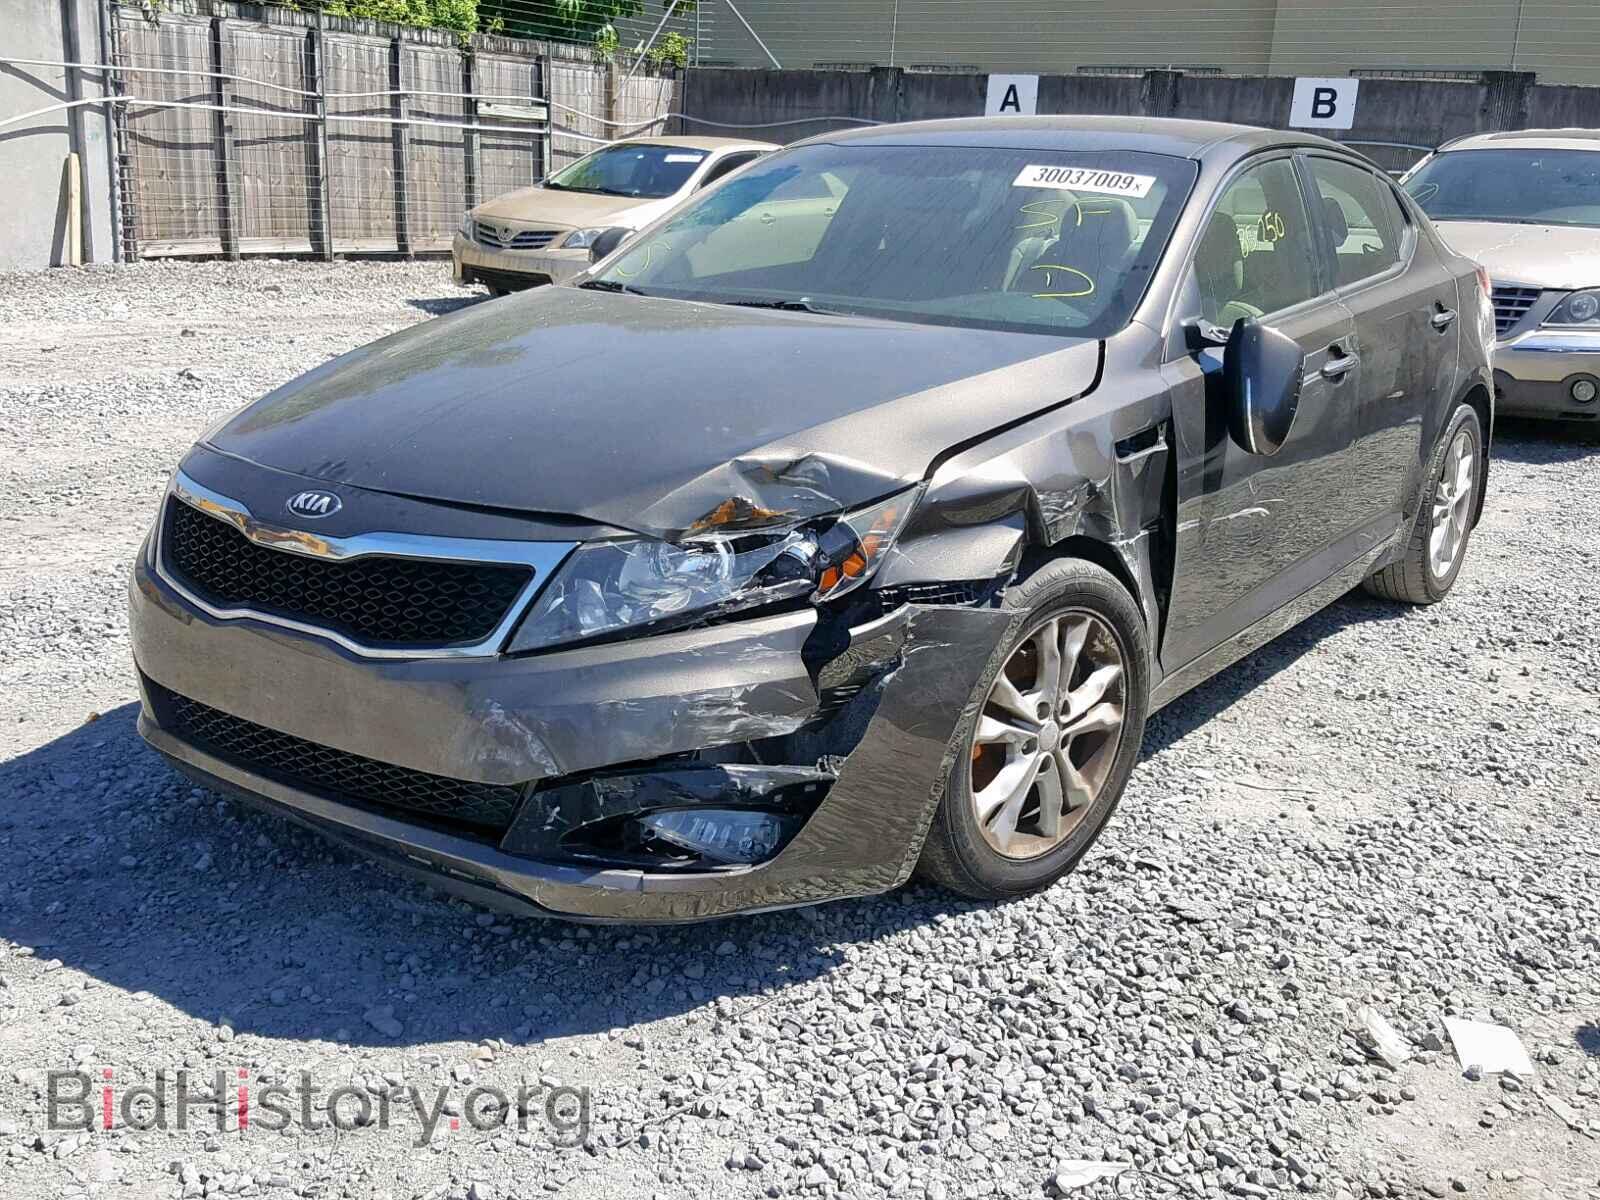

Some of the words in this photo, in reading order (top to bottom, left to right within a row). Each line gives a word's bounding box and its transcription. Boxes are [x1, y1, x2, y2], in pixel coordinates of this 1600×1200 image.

[1000, 84, 1021, 112] A
[1311, 88, 1337, 119] B
[293, 492, 331, 513] KIA
